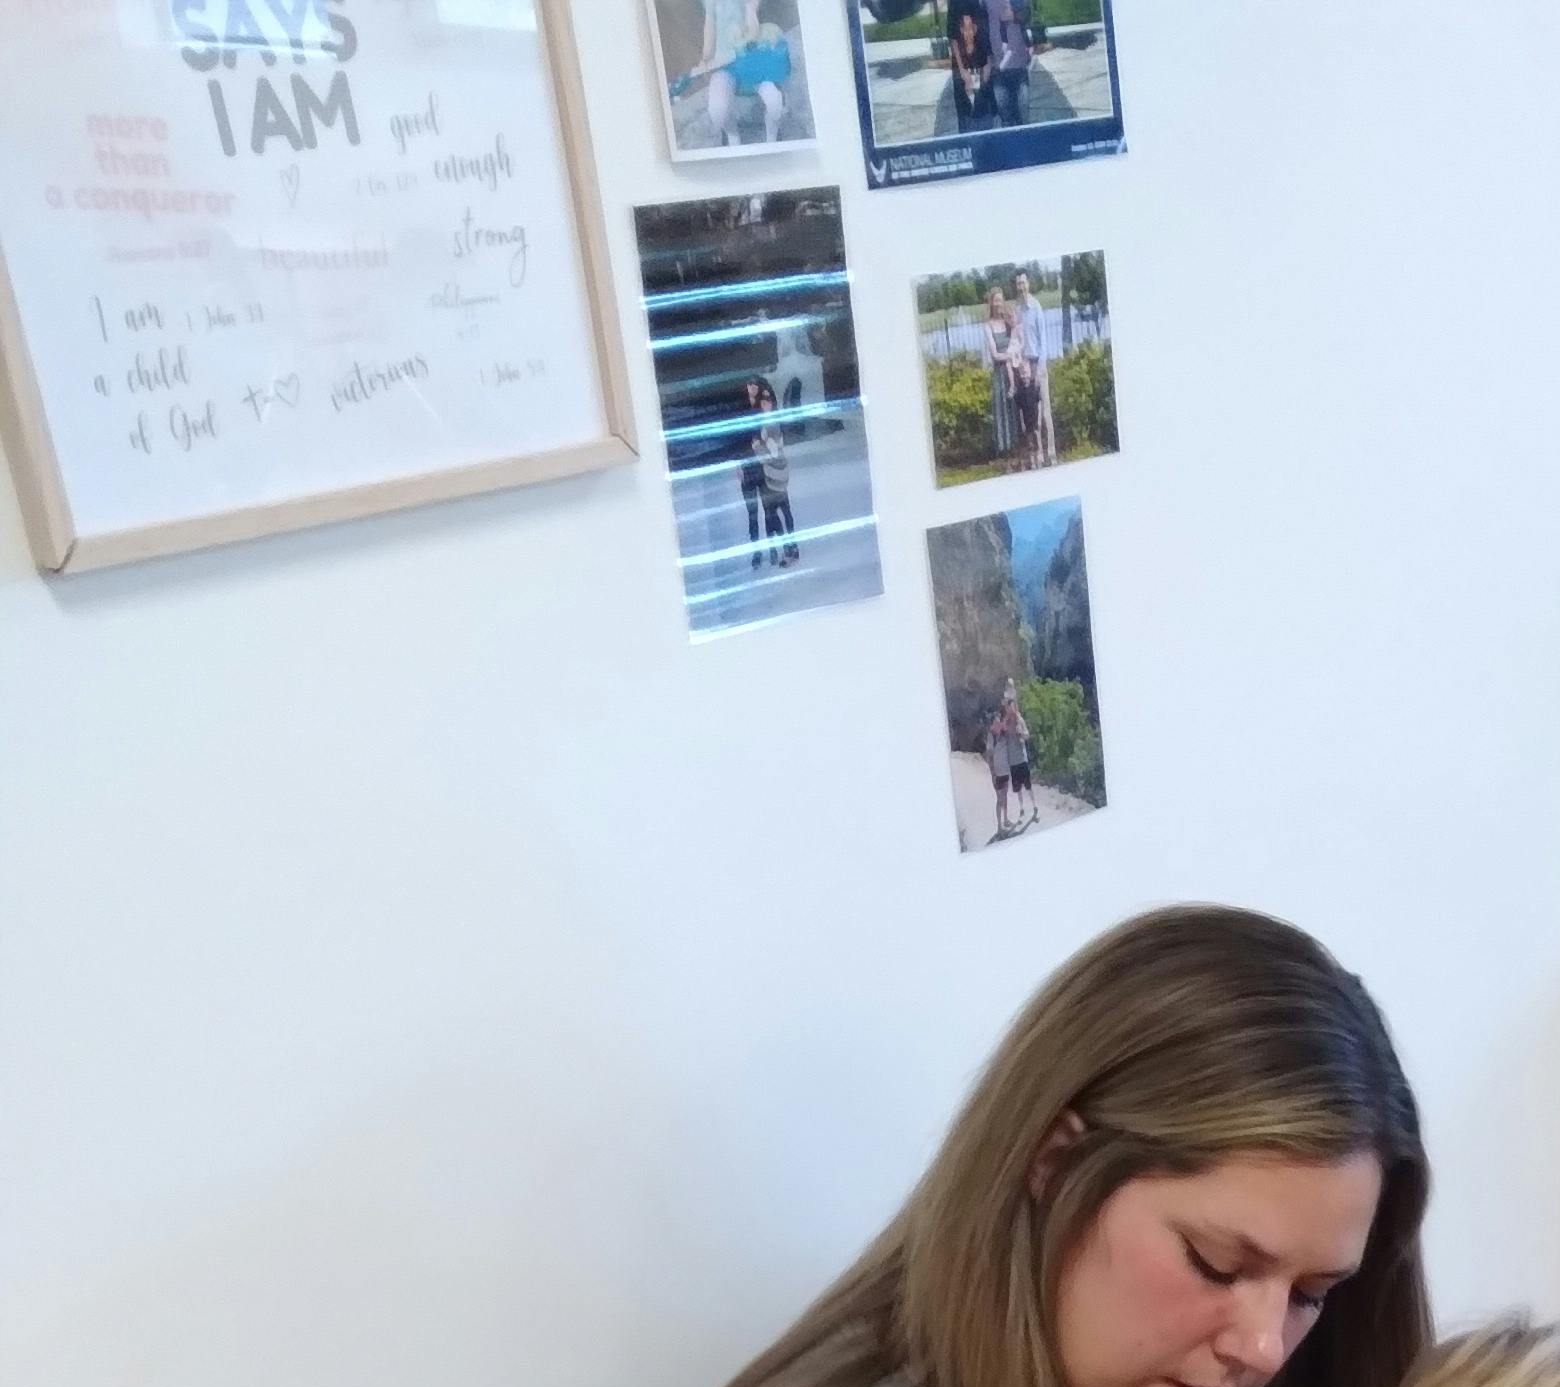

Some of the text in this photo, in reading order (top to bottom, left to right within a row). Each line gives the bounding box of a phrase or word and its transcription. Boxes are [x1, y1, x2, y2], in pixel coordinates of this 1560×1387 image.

[171, 0, 358, 72] SAYS
[86, 114, 169, 140] more
[207, 70, 361, 157] I AM
[96, 143, 171, 176] than
[73, 187, 236, 221] conqueror
[454, 206, 528, 287] strong
